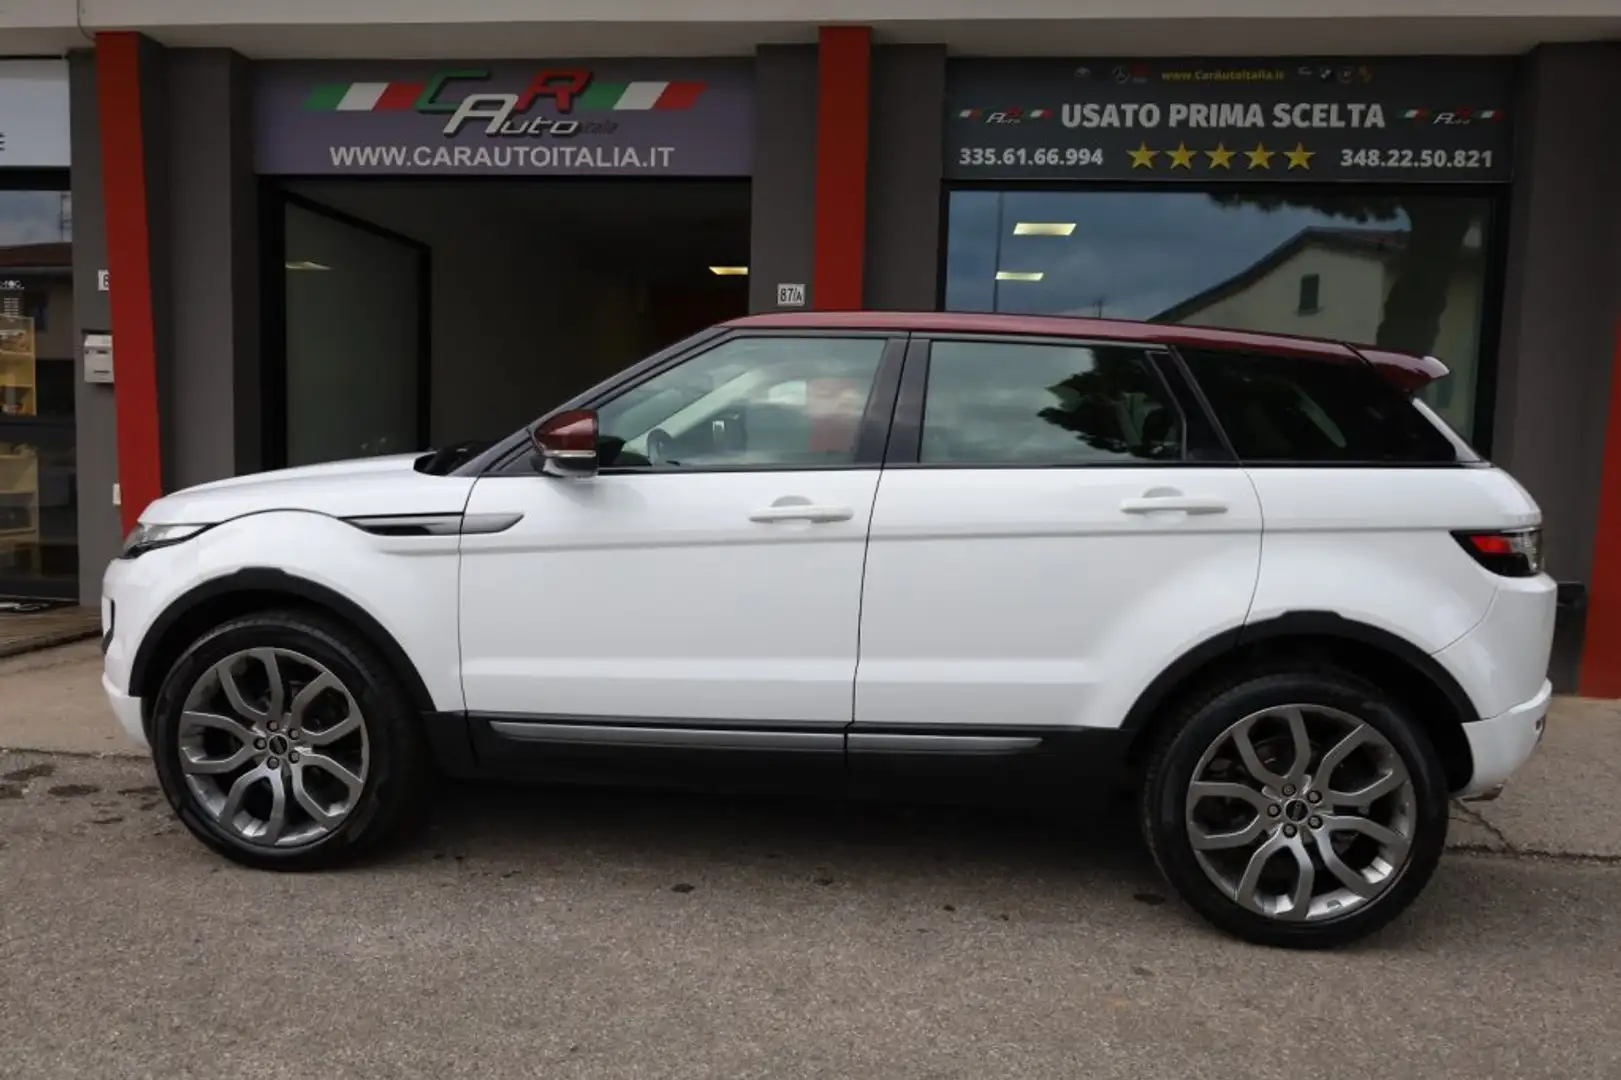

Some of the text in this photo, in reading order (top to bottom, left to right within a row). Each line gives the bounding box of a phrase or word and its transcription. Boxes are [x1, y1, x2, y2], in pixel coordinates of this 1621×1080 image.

[1061, 102, 1386, 128] USATO PRIMA SCELTA
[329, 145, 675, 168] WWW.CARAUTOITALIA.IT
[958, 147, 1104, 166] 335.61.66.994
[1340, 148, 1494, 168] 348.22.50.821
